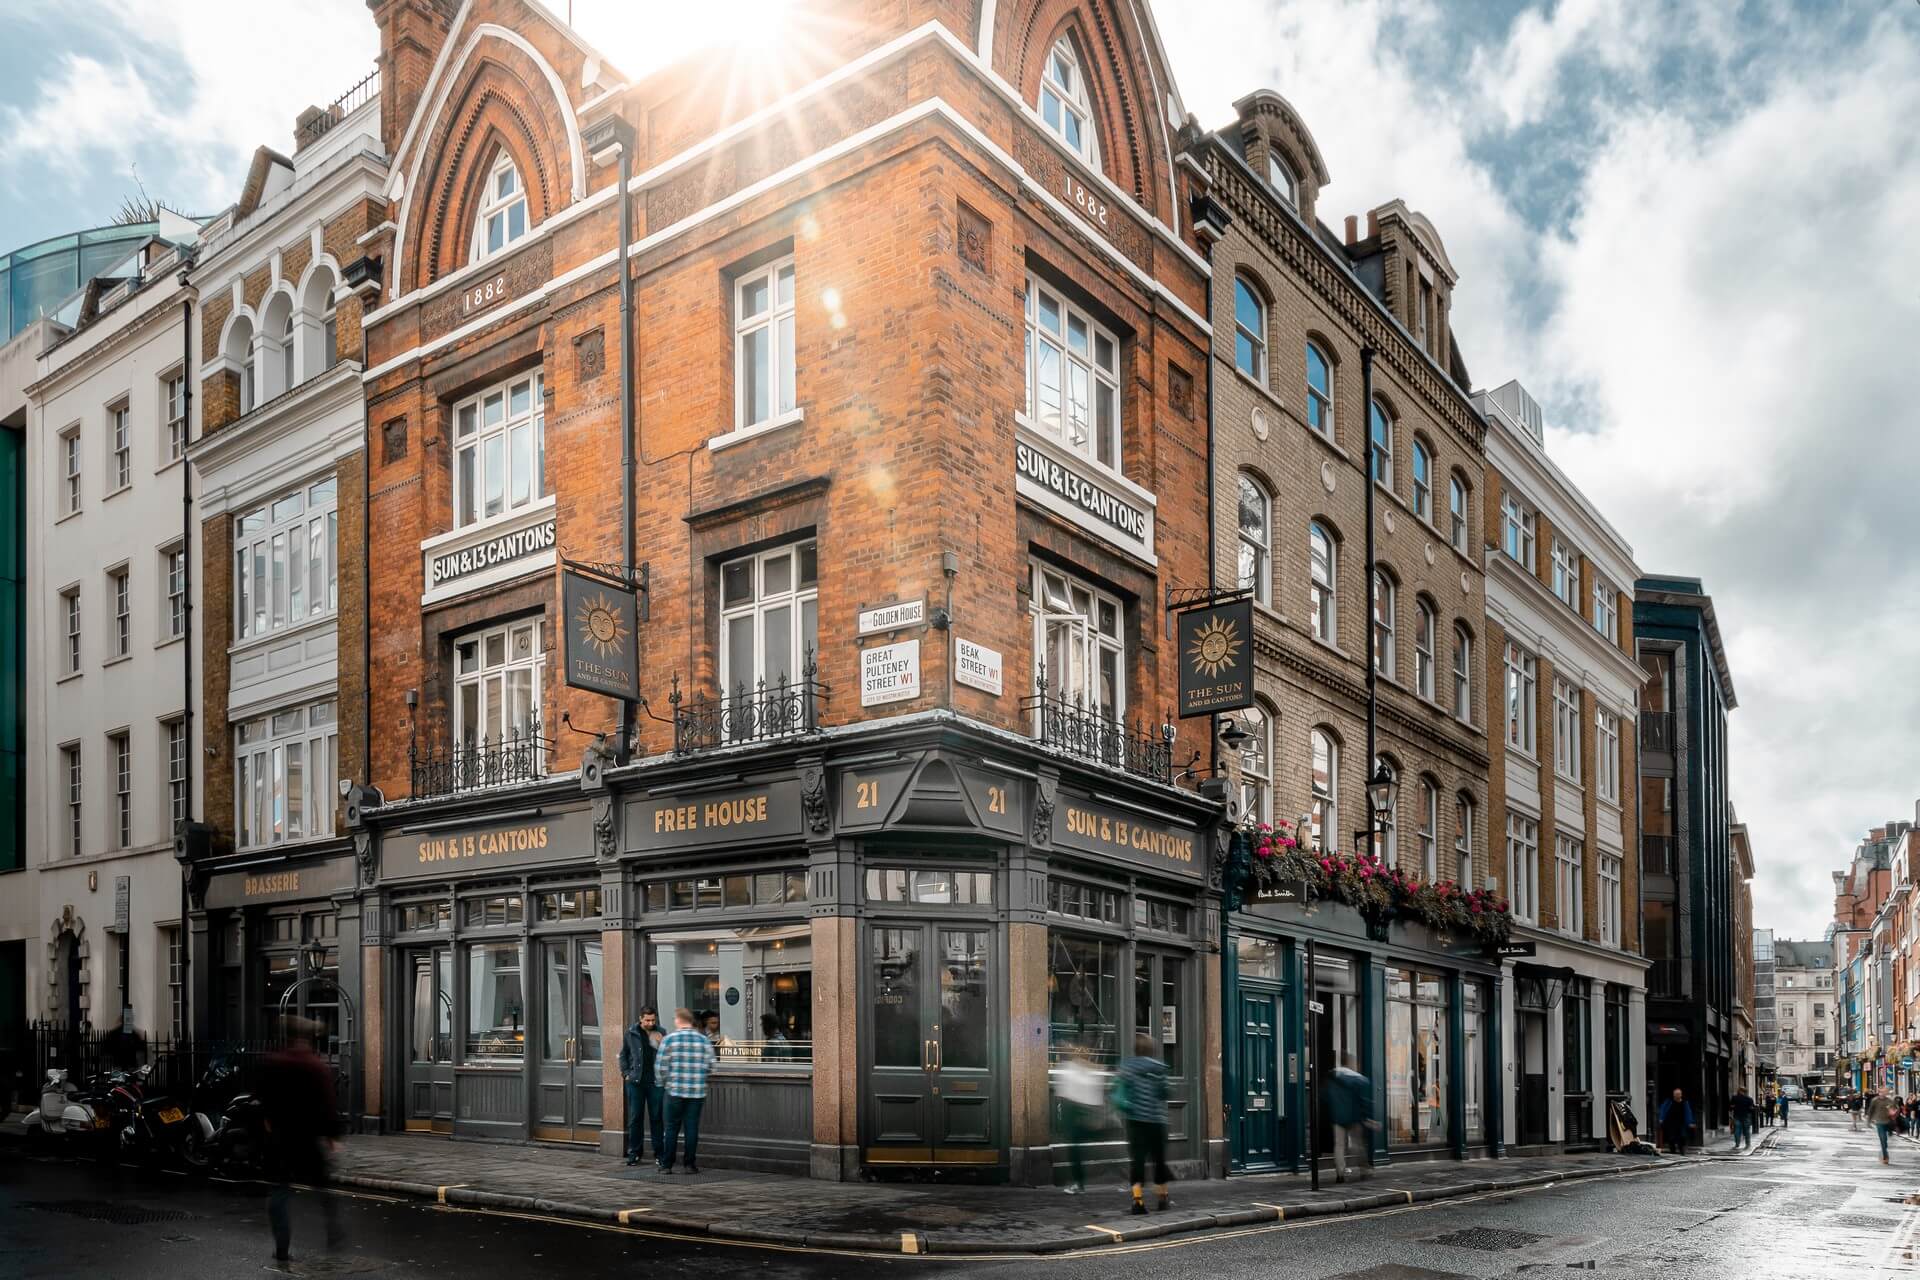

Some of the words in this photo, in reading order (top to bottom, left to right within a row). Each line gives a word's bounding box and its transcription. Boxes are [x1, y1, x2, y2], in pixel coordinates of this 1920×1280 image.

[1066, 176, 1106, 225] 1882
[465, 277, 504, 310] 1882
[873, 609, 899, 627] GOLDEN
[899, 605, 922, 623] HOUSE
[866, 649, 893, 665] GREAT
[961, 643, 979, 661] BEAK
[575, 659, 601, 675] THE
[604, 667, 629, 682] SUN
[866, 659, 909, 678] PULTENEY
[961, 657, 987, 676] STREET
[988, 666, 999, 681] W1
[866, 675, 896, 691] STREET
[900, 672, 913, 685] W1
[1188, 687, 1213, 699] THE
[1216, 682, 1242, 695] SUN
[856, 781, 879, 809] 21
[988, 786, 1006, 814] 21
[655, 806, 697, 833] FREE
[704, 797, 768, 826] HOUSE
[419, 841, 446, 862] SUN
[448, 839, 459, 858] &
[463, 836, 475, 857] 13
[479, 827, 547, 855] CANTONS
[1067, 808, 1097, 838] SUN
[1101, 817, 1112, 841] &
[1115, 822, 1128, 846] 13
[1131, 826, 1192, 862] CANTONS
[245, 873, 299, 896] BRASSERIE
